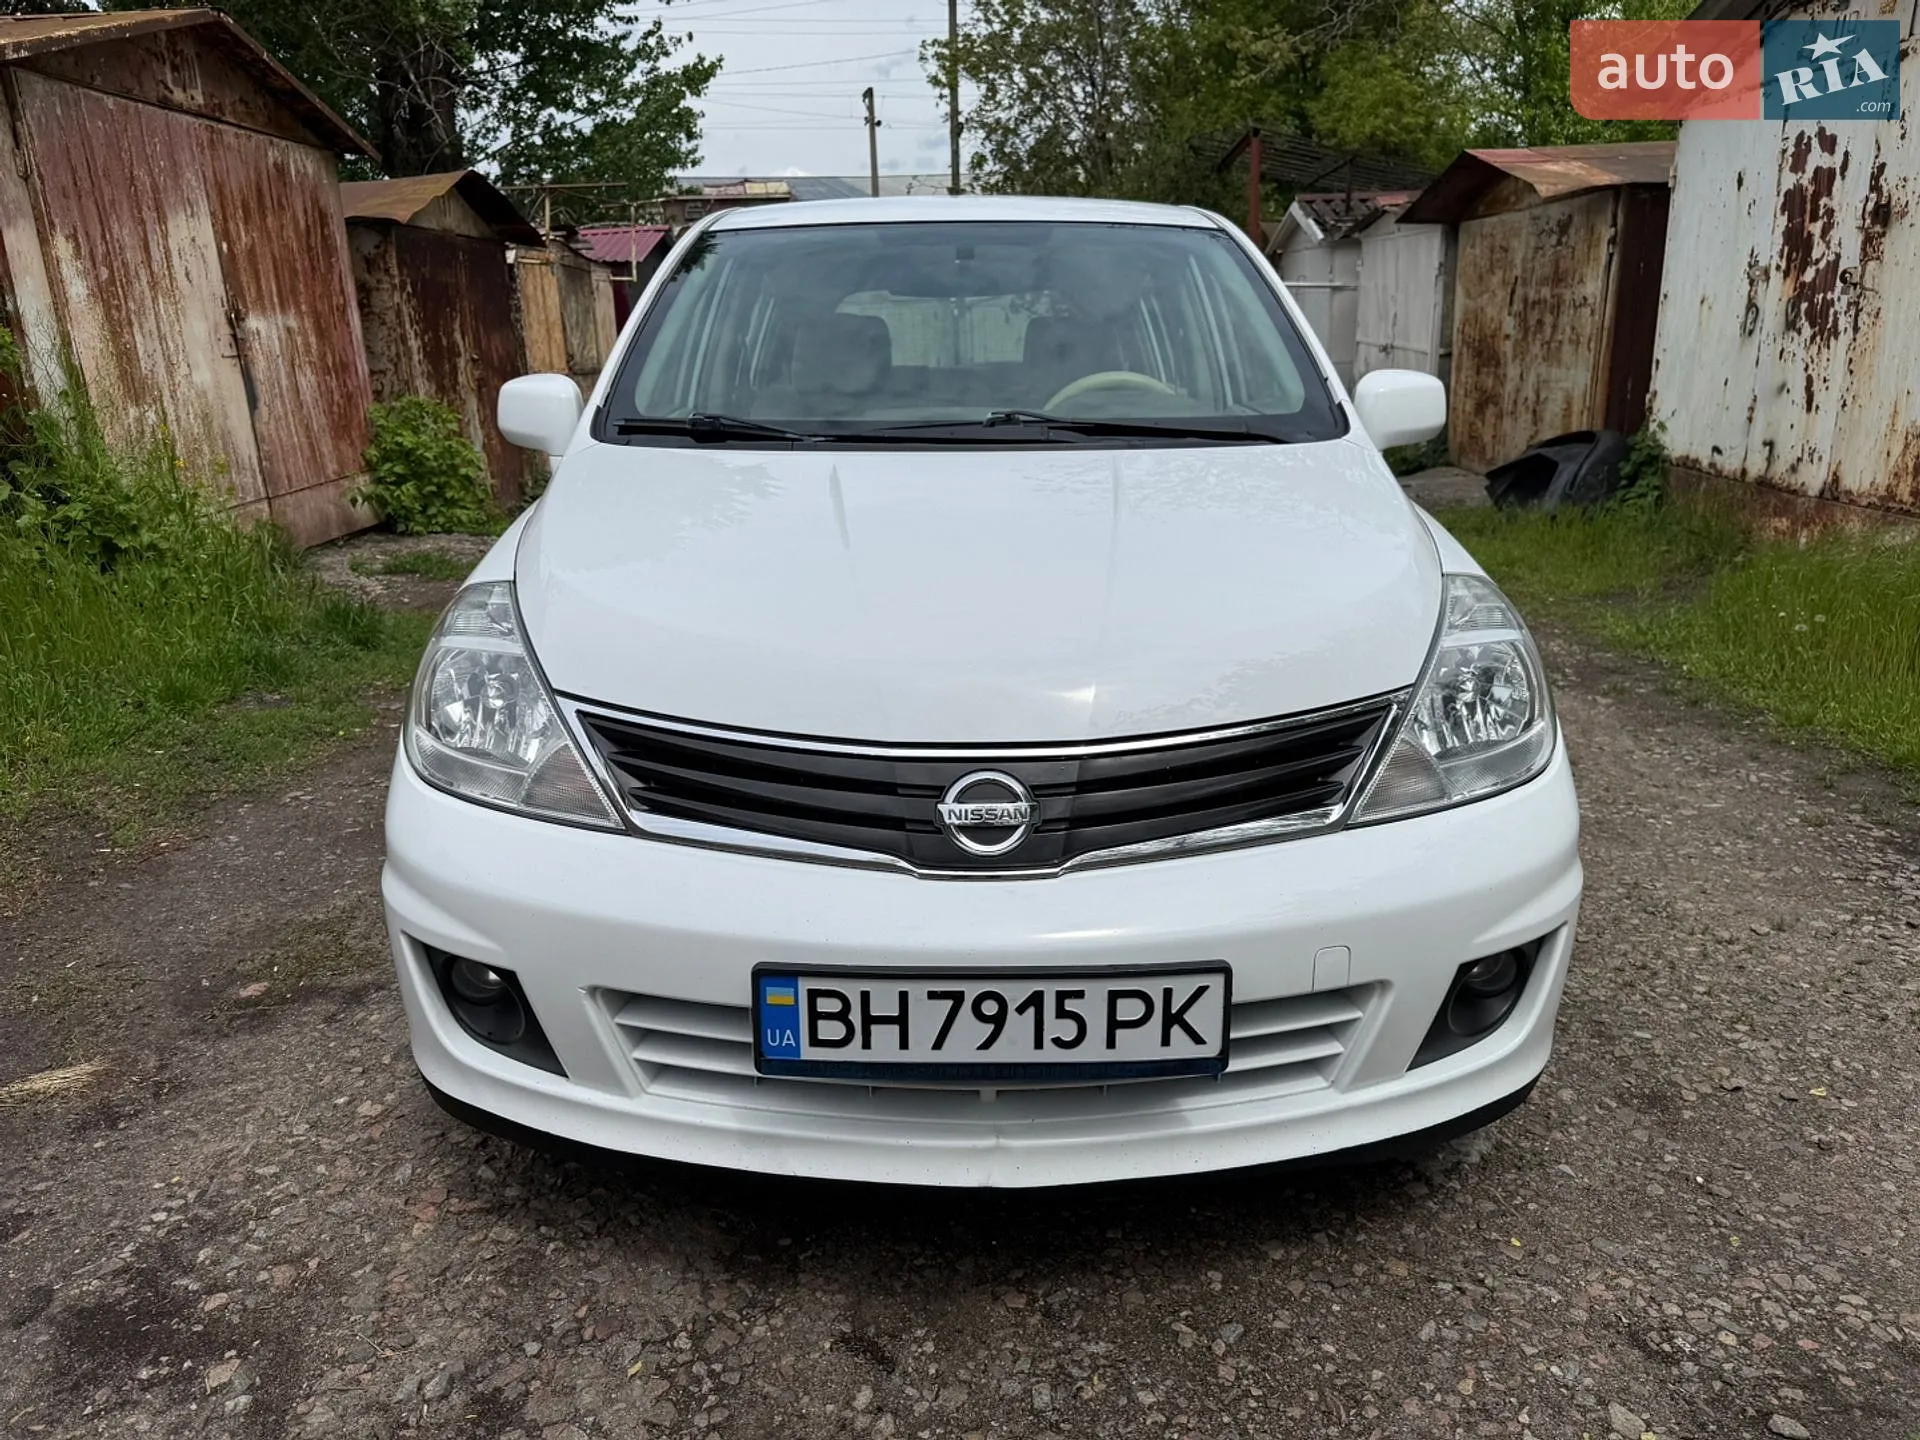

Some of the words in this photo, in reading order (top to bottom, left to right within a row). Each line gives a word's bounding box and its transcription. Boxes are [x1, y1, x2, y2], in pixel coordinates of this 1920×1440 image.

[947, 807, 1029, 821] NISSAN
[806, 987, 910, 1051] BH
[926, 988, 1088, 1051] 7915
[1105, 984, 1211, 1050] PK
[766, 1028, 796, 1048] UA
